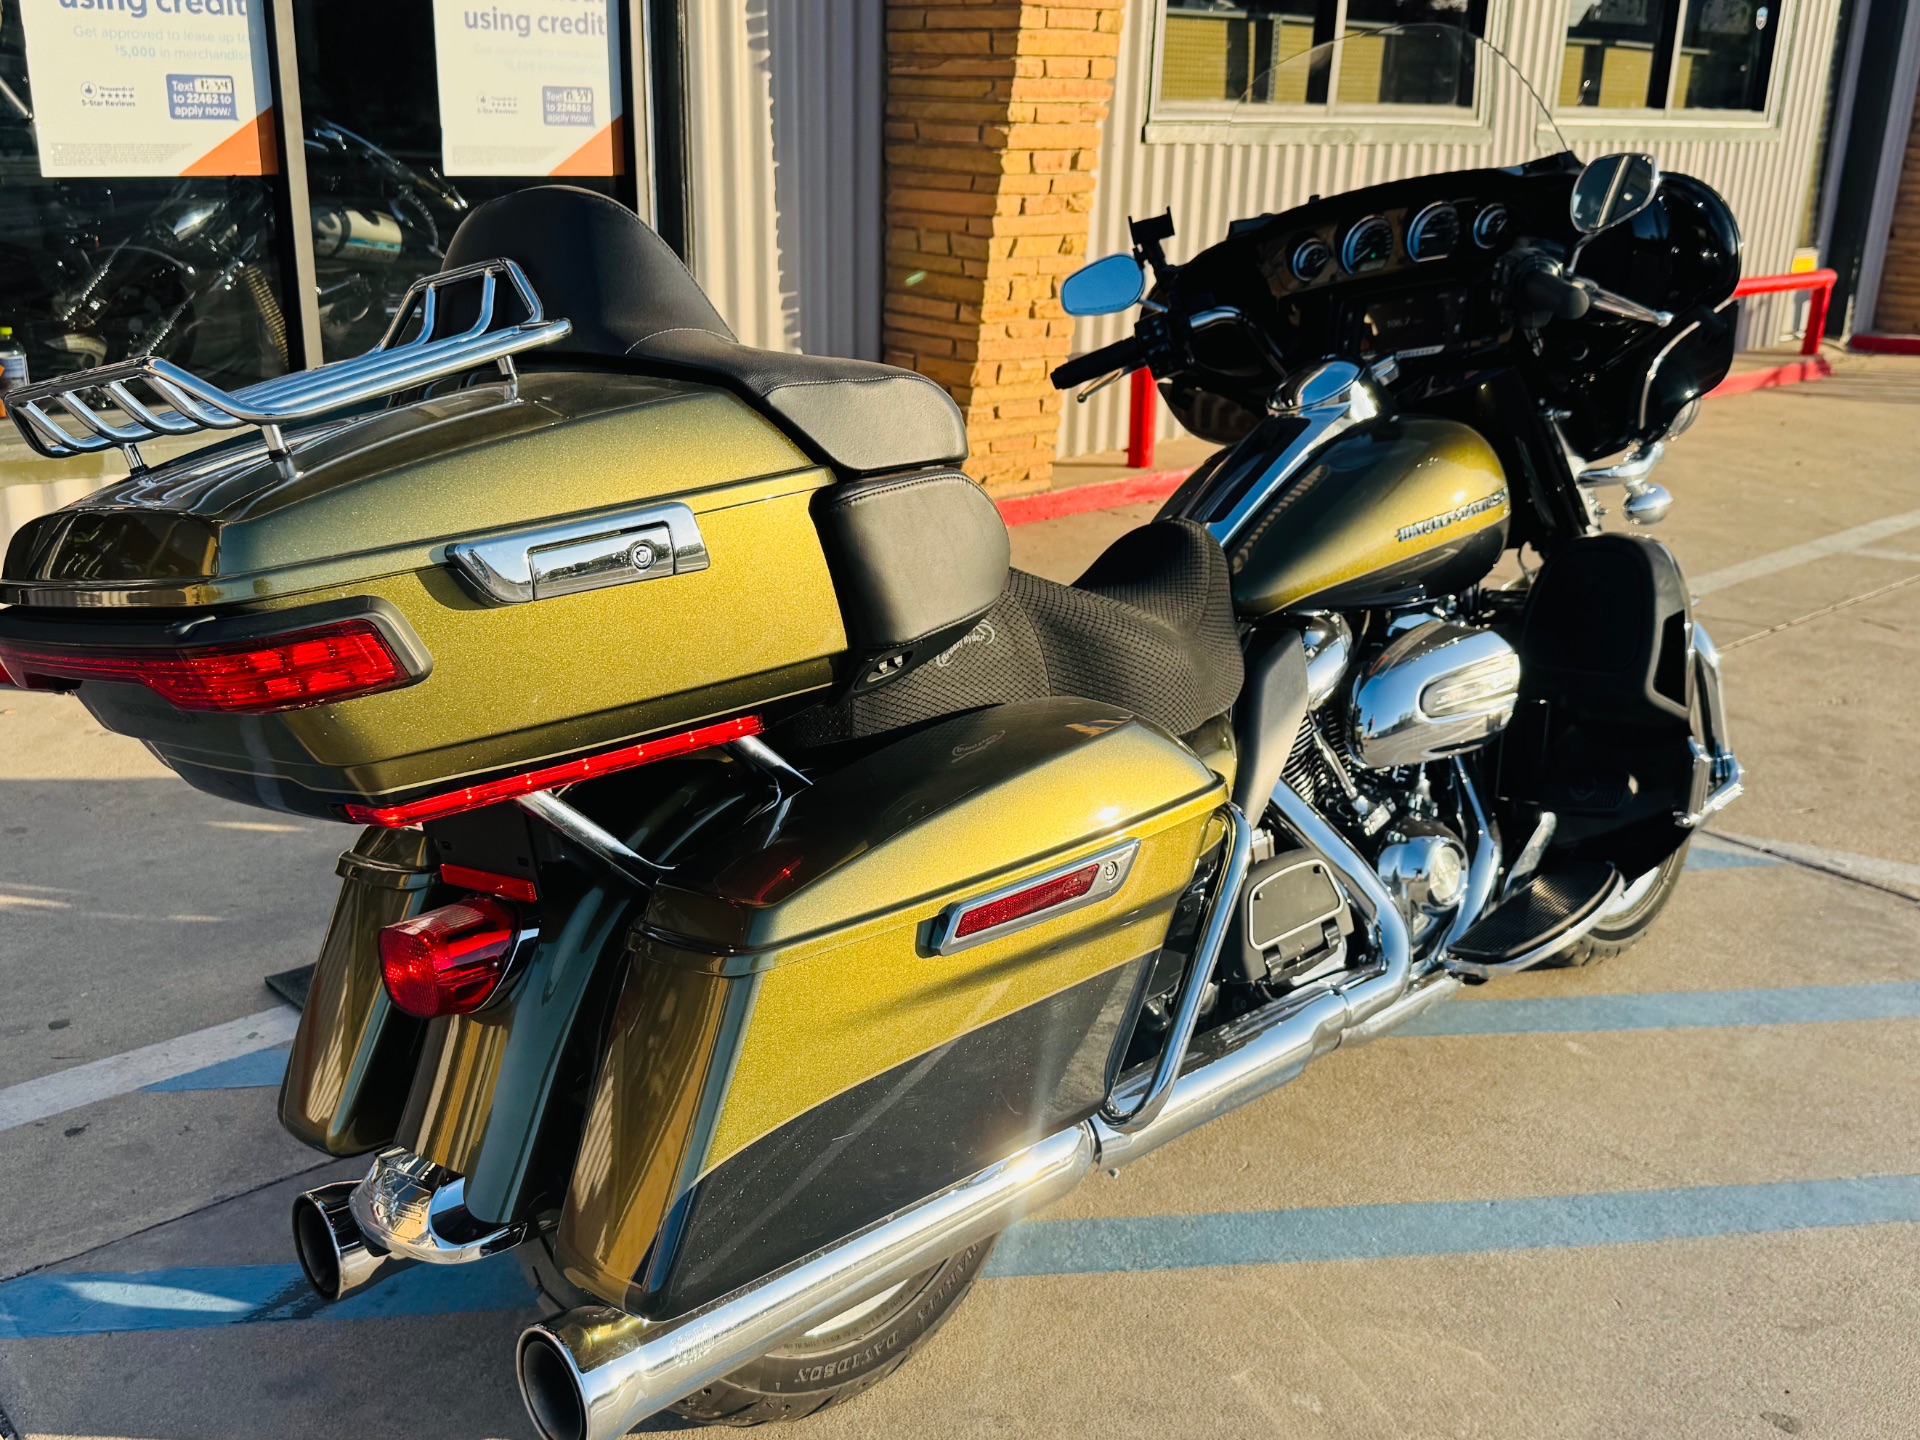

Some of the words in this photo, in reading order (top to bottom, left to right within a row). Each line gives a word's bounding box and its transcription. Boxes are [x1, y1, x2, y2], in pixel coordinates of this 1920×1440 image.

[464, 6, 531, 38] using
[537, 12, 606, 36] credit
[73, 25, 98, 38] Get
[101, 28, 164, 42] approved
[167, 30, 181, 41] to
[184, 29, 215, 42] lease
[218, 33, 235, 44] up
[115, 44, 157, 58] $5,000
[160, 47, 171, 57] in
[172, 80, 194, 92] Text
[81, 99, 104, 107] 5-Star
[105, 99, 136, 108] Reviews
[173, 93, 185, 104] to
[187, 93, 219, 104] 22462
[220, 94, 232, 104] to
[174, 105, 203, 118] apply
[547, 113, 570, 125] apply
[794, 1329, 900, 1383] DAVIDSON
